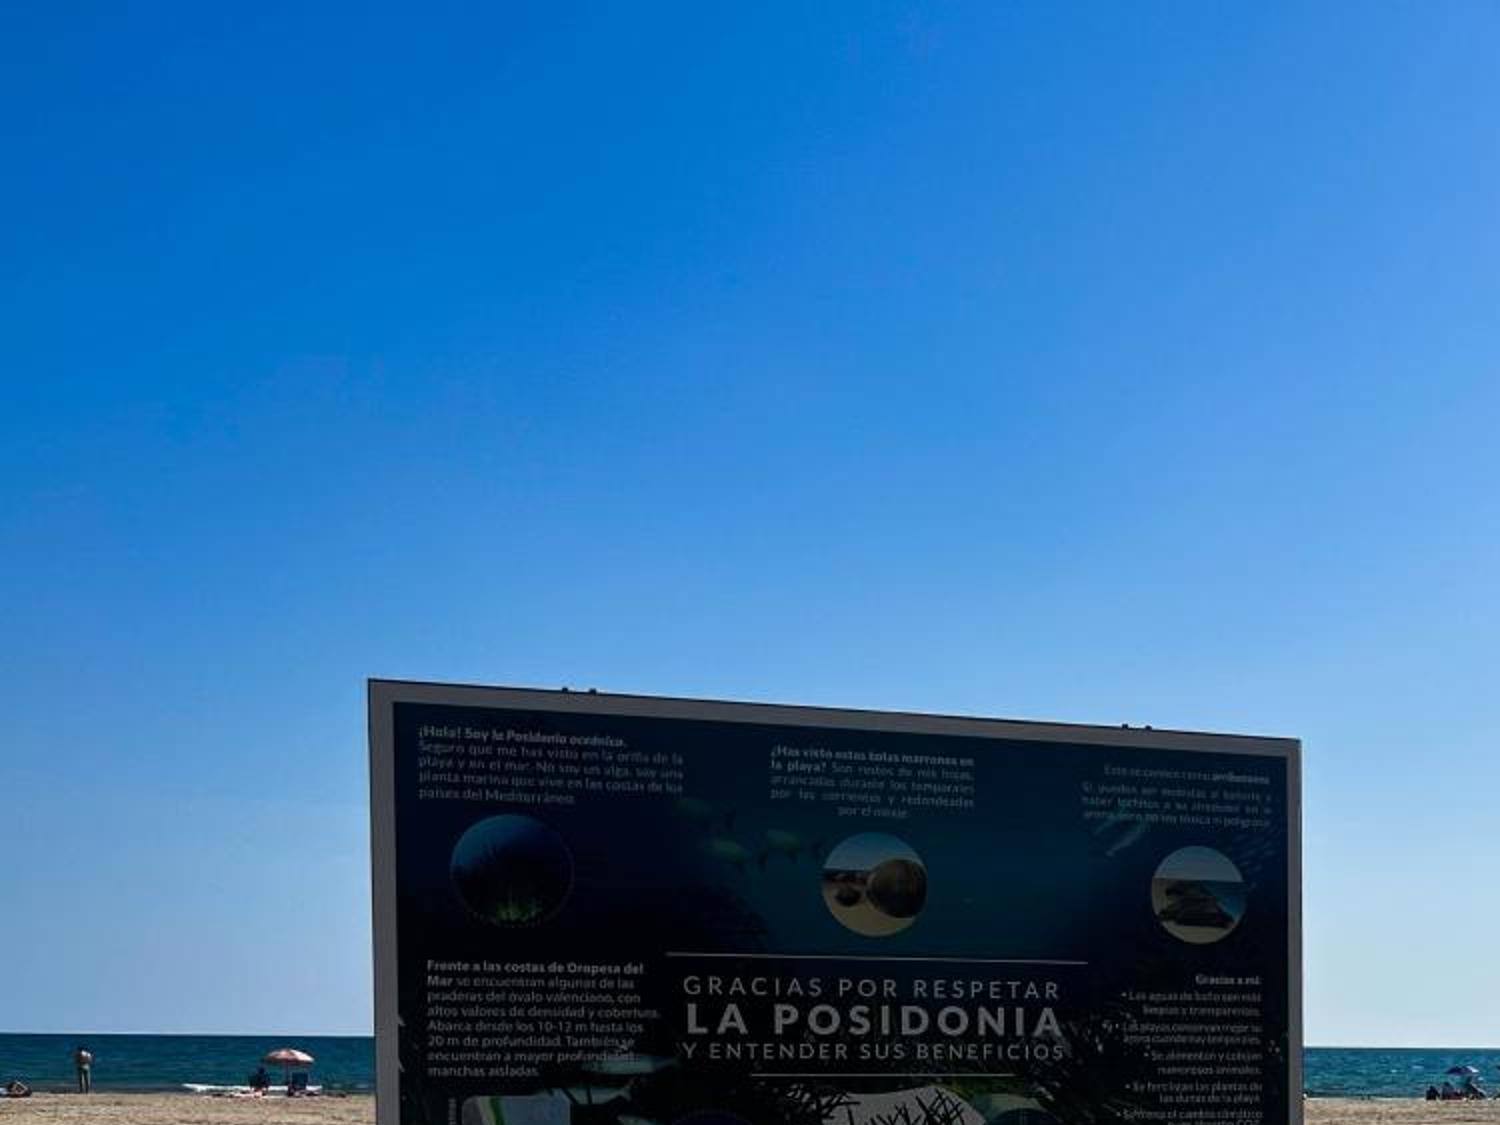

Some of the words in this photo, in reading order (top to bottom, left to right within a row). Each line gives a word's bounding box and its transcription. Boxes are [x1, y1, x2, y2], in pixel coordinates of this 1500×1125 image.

[428, 959, 470, 971] Frente
[483, 960, 500, 972] las
[504, 961, 545, 972] costas
[548, 961, 565, 973] de
[567, 962, 620, 977] Oropesa
[624, 963, 643, 974] del
[428, 976, 453, 987] Mar
[600, 978, 614, 988] de
[683, 976, 823, 998] GRACIAS
[839, 979, 897, 998] POR
[913, 980, 1059, 1000] RESPETAR
[460, 1007, 506, 1017] valores
[509, 1007, 525, 1017] de
[427, 1021, 472, 1031] Abarca
[516, 1022, 535, 1032] los
[687, 1004, 749, 1035] LA
[773, 1004, 1063, 1037] POSIDONIA
[428, 1036, 445, 1046] 20
[447, 1038, 460, 1046] m
[463, 1036, 479, 1046] de
[682, 1043, 697, 1060] Y
[709, 1043, 848, 1060] ENTENDER
[859, 1044, 906, 1060] SUS
[916, 1044, 1064, 1061] BENEFICIOS
